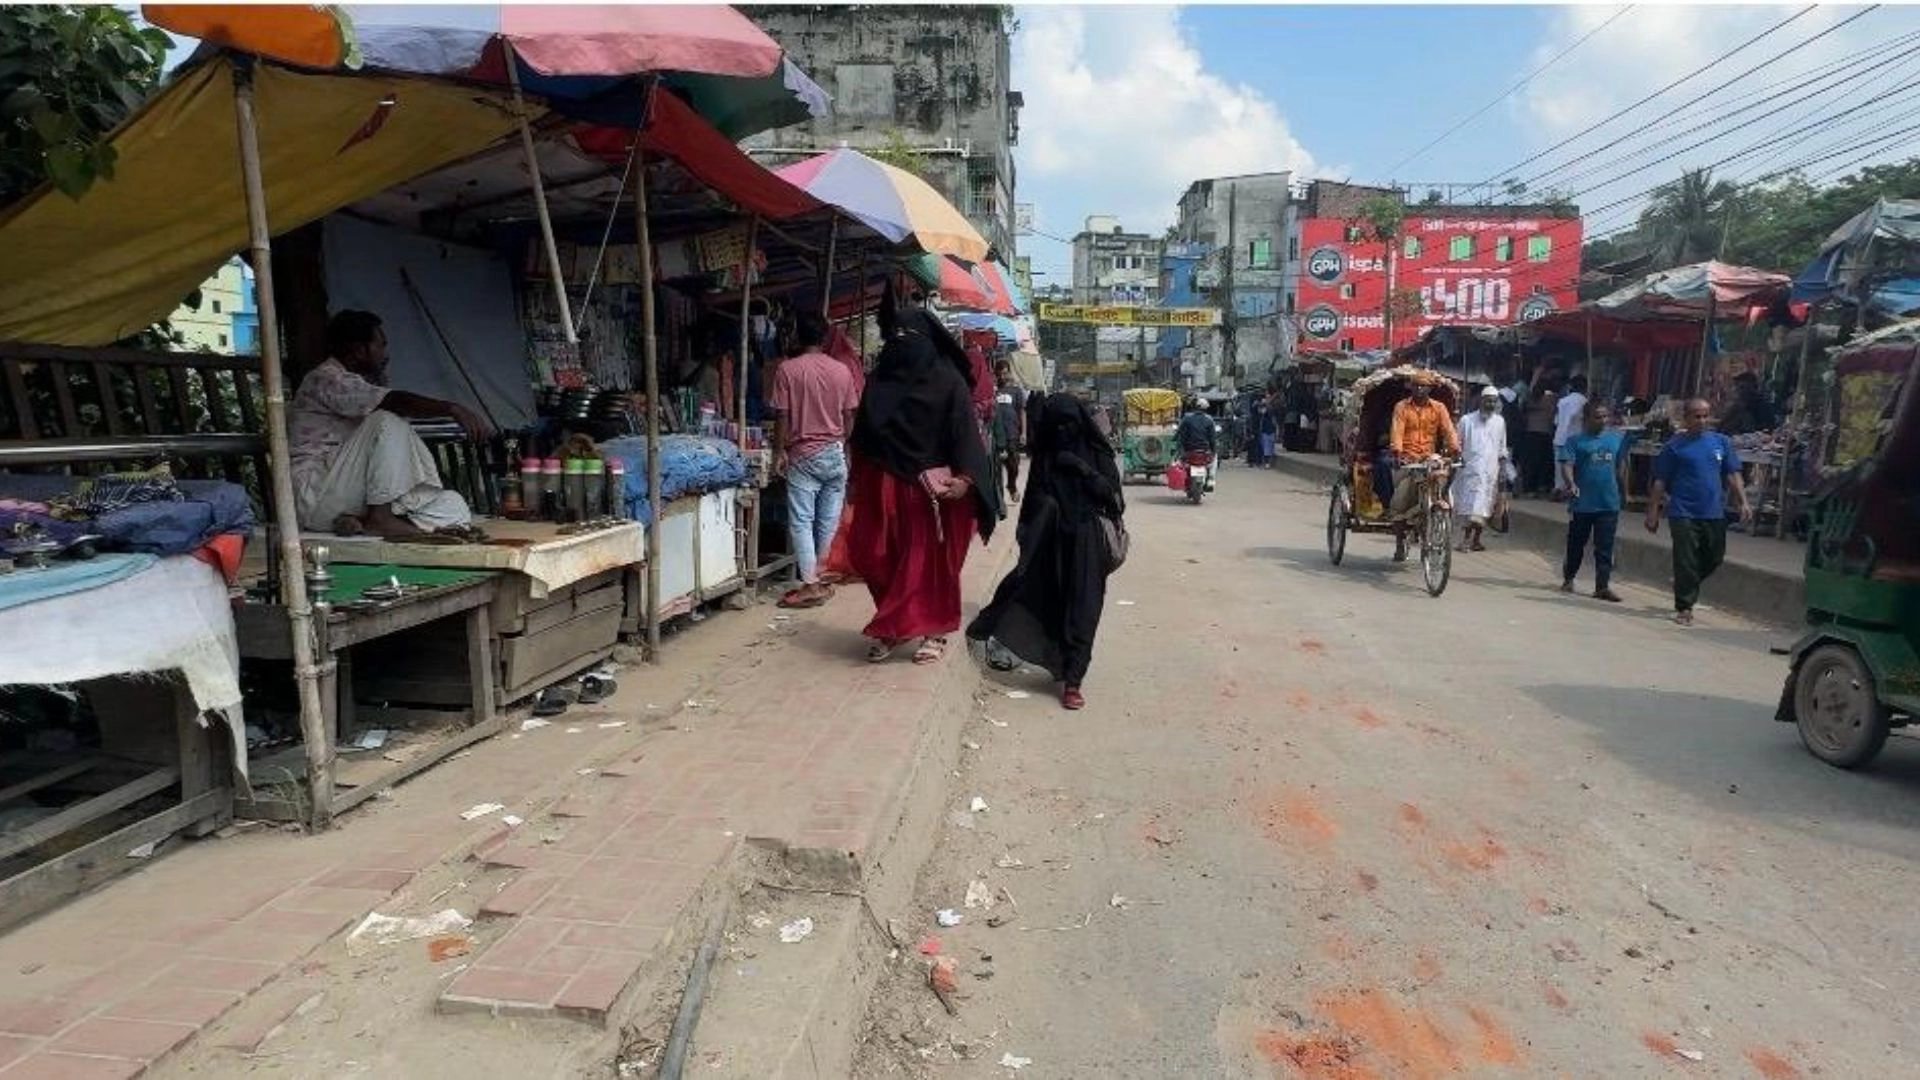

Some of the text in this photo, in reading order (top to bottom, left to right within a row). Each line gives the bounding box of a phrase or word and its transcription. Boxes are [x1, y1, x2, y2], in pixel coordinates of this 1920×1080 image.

[1311, 259, 1340, 275] GPH
[1349, 253, 1384, 273] ispa
[1308, 317, 1337, 332] GPH
